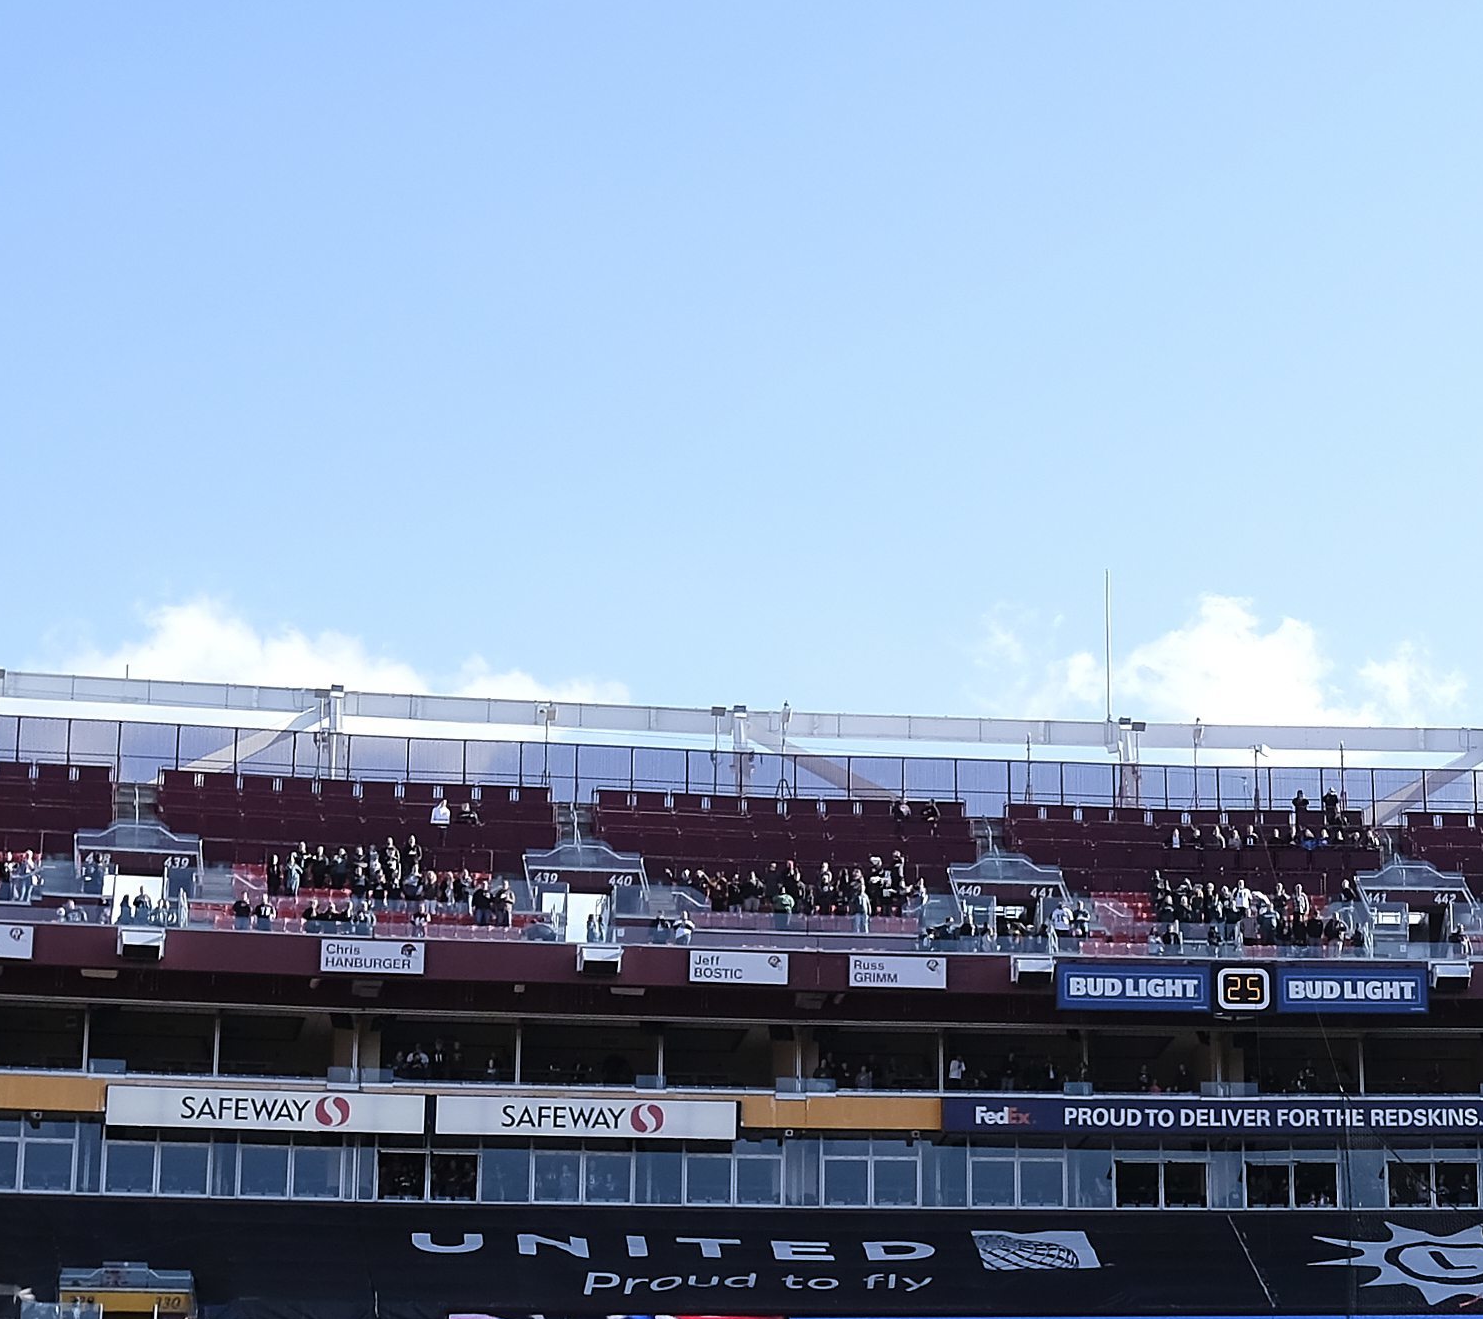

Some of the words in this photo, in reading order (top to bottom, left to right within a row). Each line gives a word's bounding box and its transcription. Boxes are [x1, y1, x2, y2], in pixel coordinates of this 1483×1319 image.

[608, 874, 633, 887] 440
[1434, 893, 1456, 904] 442
[325, 943, 360, 957] Chris
[325, 956, 412, 970] HANBURGER
[694, 954, 720, 966] Jeff
[853, 959, 885, 971] Russ
[693, 967, 743, 980] BOSTIC
[853, 972, 898, 984] GRIMM
[1069, 977, 1122, 997] BUD
[1125, 978, 1196, 998] LIGHT
[1227, 977, 1261, 1001] 25
[1288, 980, 1340, 999] BUD
[1342, 981, 1413, 1000] LIGHT
[181, 1096, 311, 1122] SAFEWAY
[501, 1104, 625, 1130] SAFEWAY
[975, 1106, 1030, 1125] FedEx
[1065, 1107, 1141, 1126] PROUD
[1145, 1108, 1175, 1127] TO
[1181, 1108, 1271, 1127] DELIVER
[1277, 1108, 1320, 1127] FOR
[1322, 1108, 1365, 1127] THE
[1371, 1107, 1483, 1127] REDSKINS.
[411, 1232, 935, 1261] UNITED
[583, 1271, 756, 1295] Proud
[781, 1273, 839, 1290] to
[863, 1273, 933, 1291] fly
